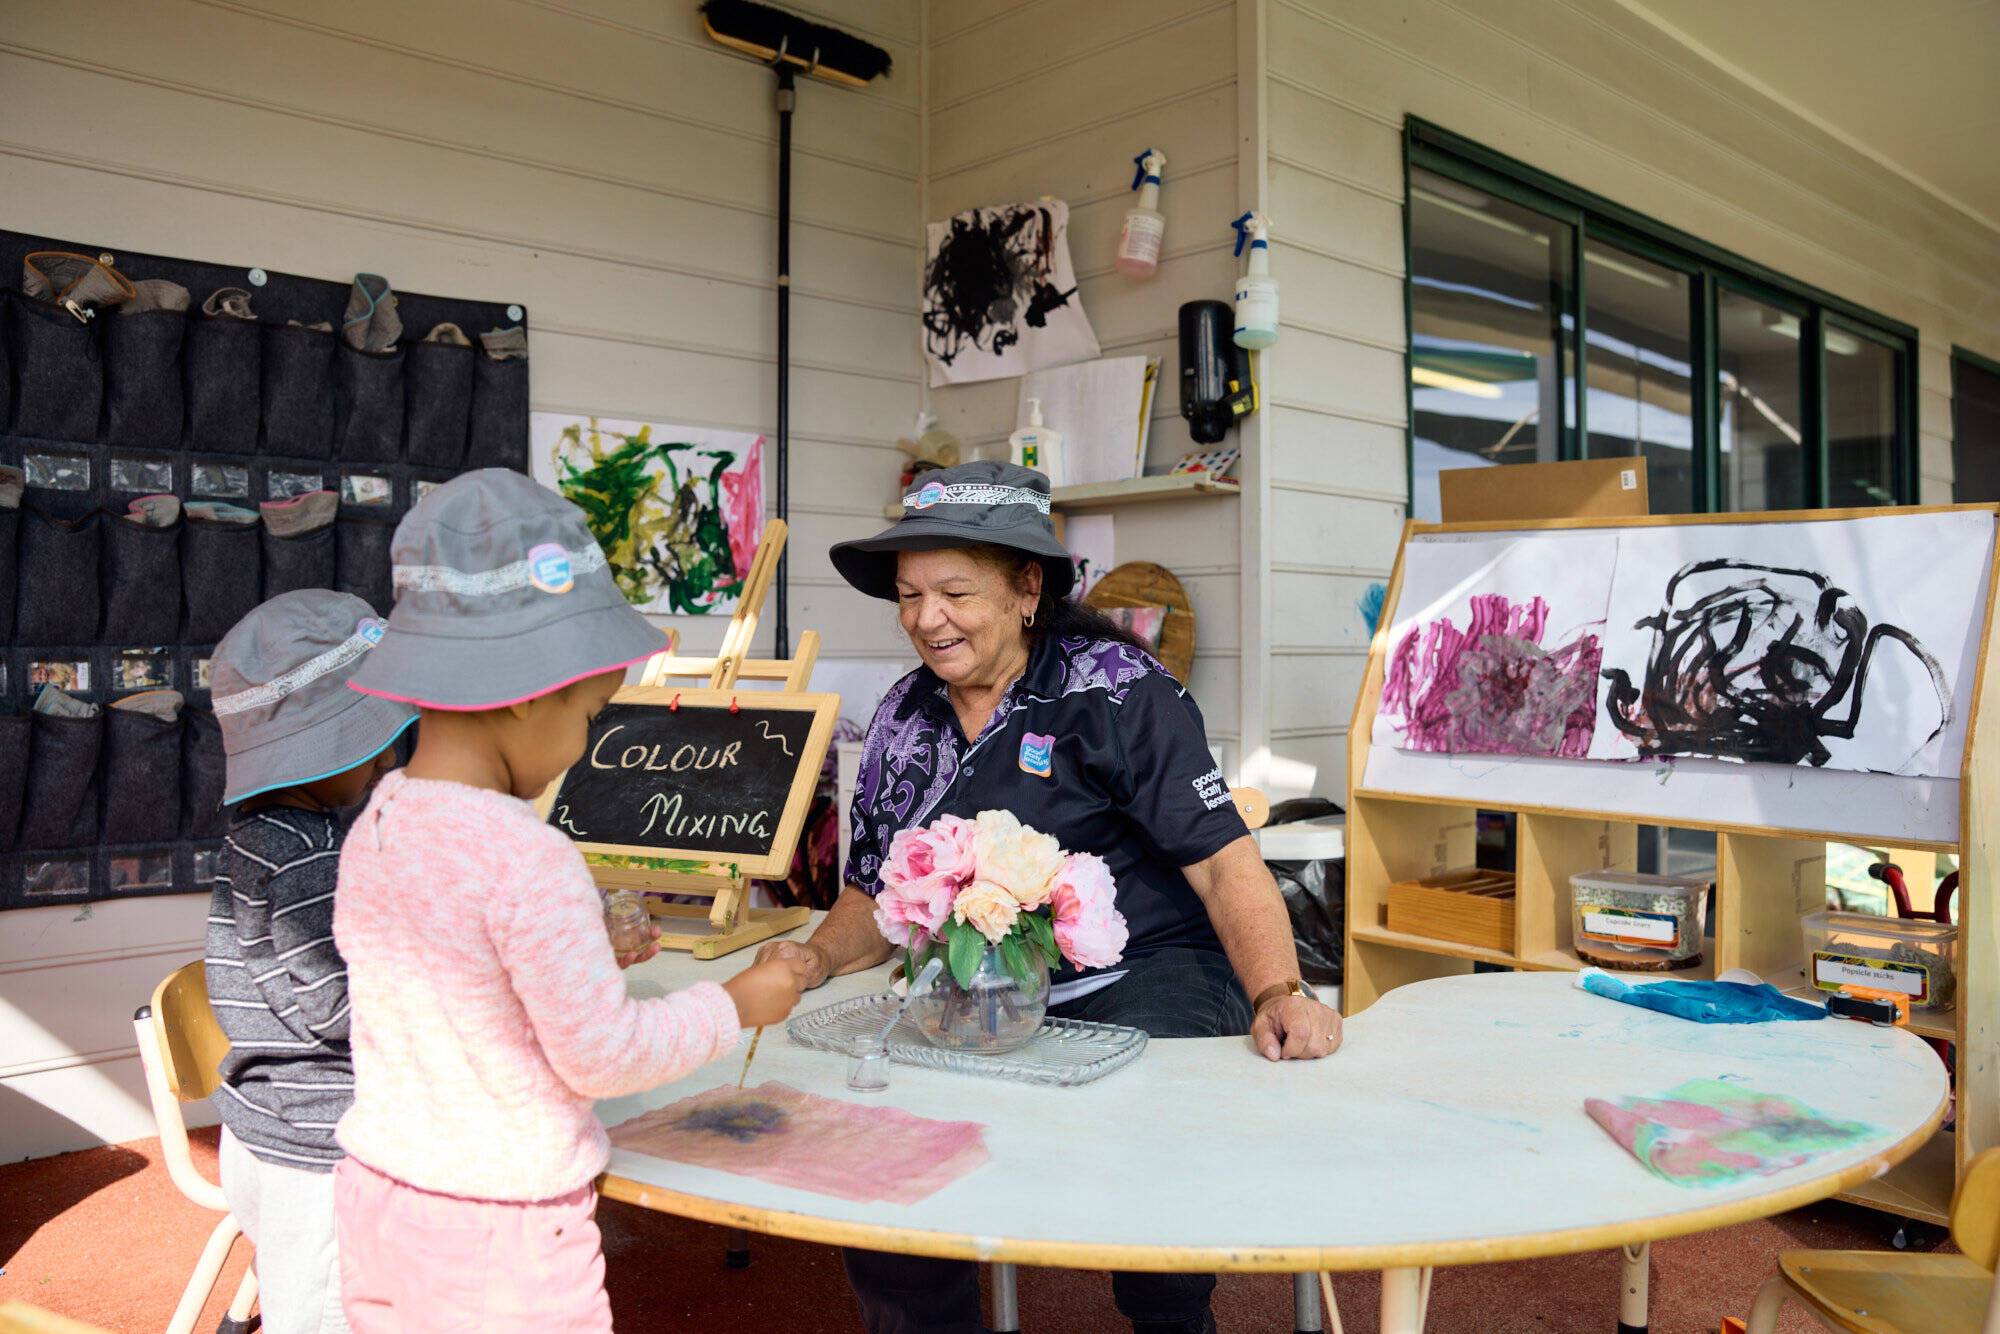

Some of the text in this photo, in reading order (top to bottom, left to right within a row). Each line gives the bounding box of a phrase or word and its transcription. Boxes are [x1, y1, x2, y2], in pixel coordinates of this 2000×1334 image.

[591, 725, 742, 772] COLOUR
[1199, 782, 1222, 799] early
[640, 793, 770, 838] MIXING
[1841, 966, 1894, 980] Popsicle sticks
